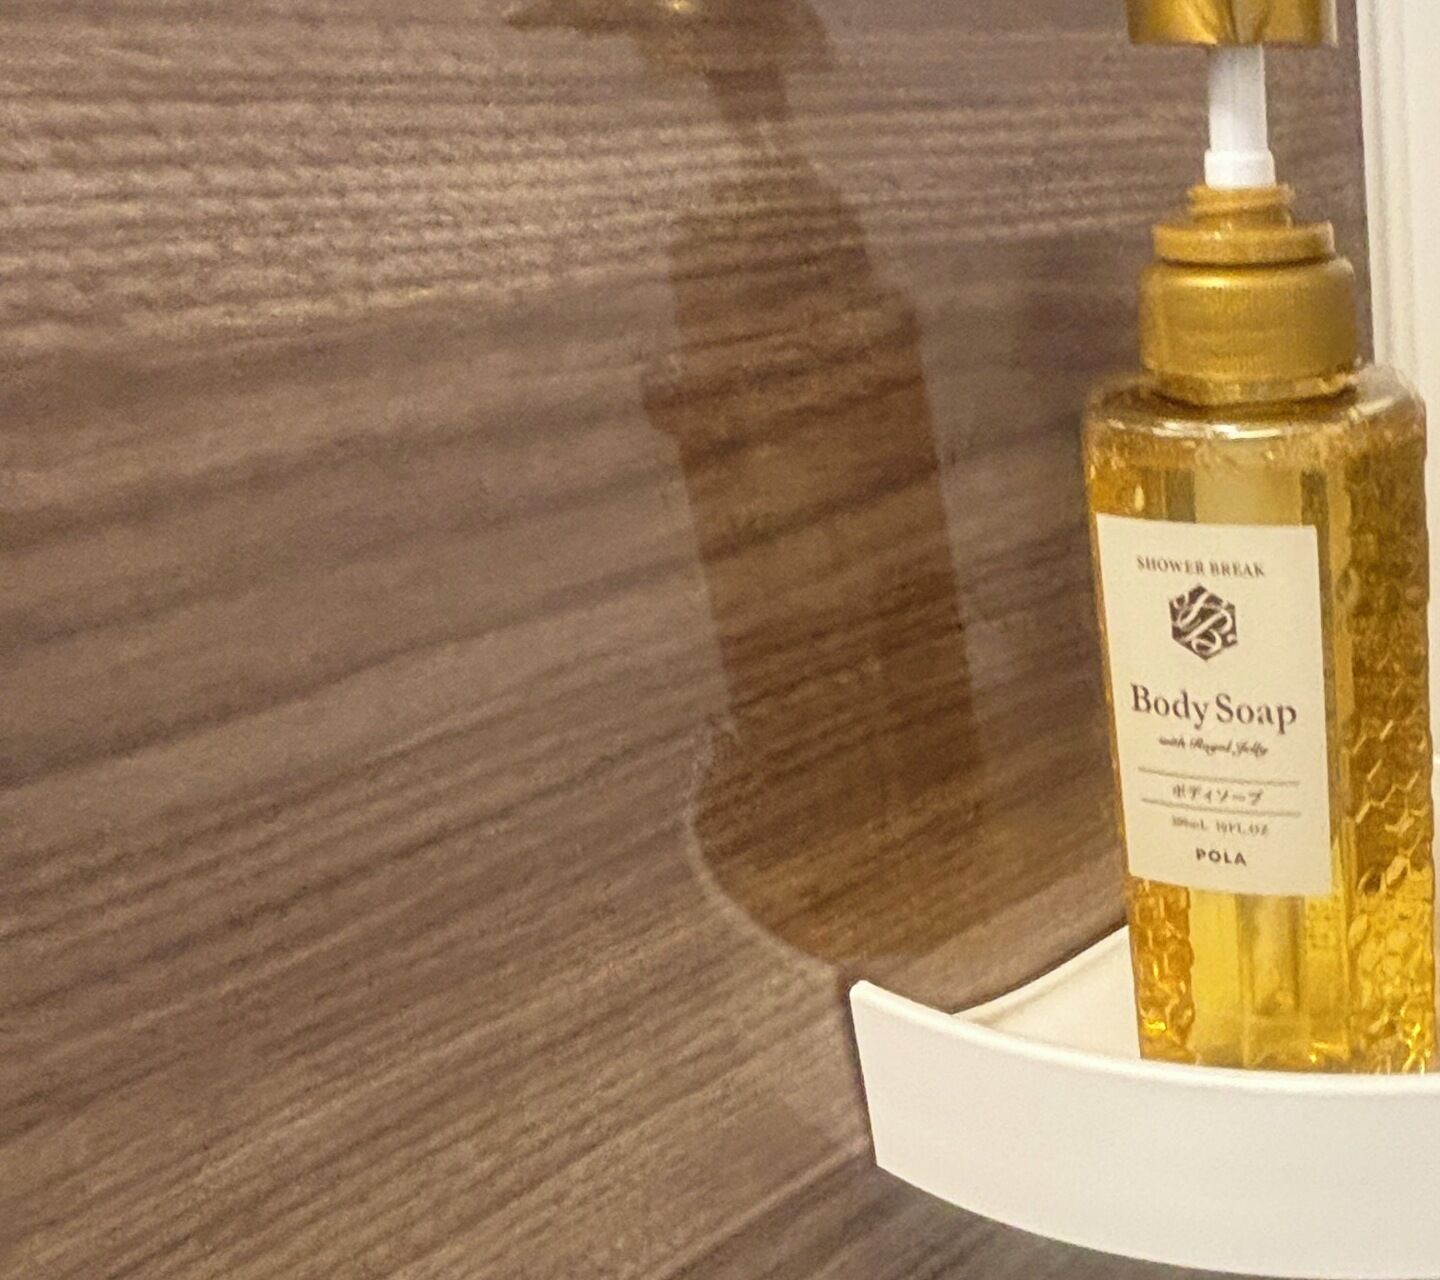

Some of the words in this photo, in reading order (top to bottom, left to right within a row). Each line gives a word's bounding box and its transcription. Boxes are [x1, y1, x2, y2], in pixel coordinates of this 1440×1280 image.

[1136, 554, 1205, 576] SHOWER
[1209, 559, 1265, 578] BREAK
[1130, 682, 1209, 730] Body
[1215, 692, 1297, 734] Soap
[1195, 847, 1248, 867] POLA
